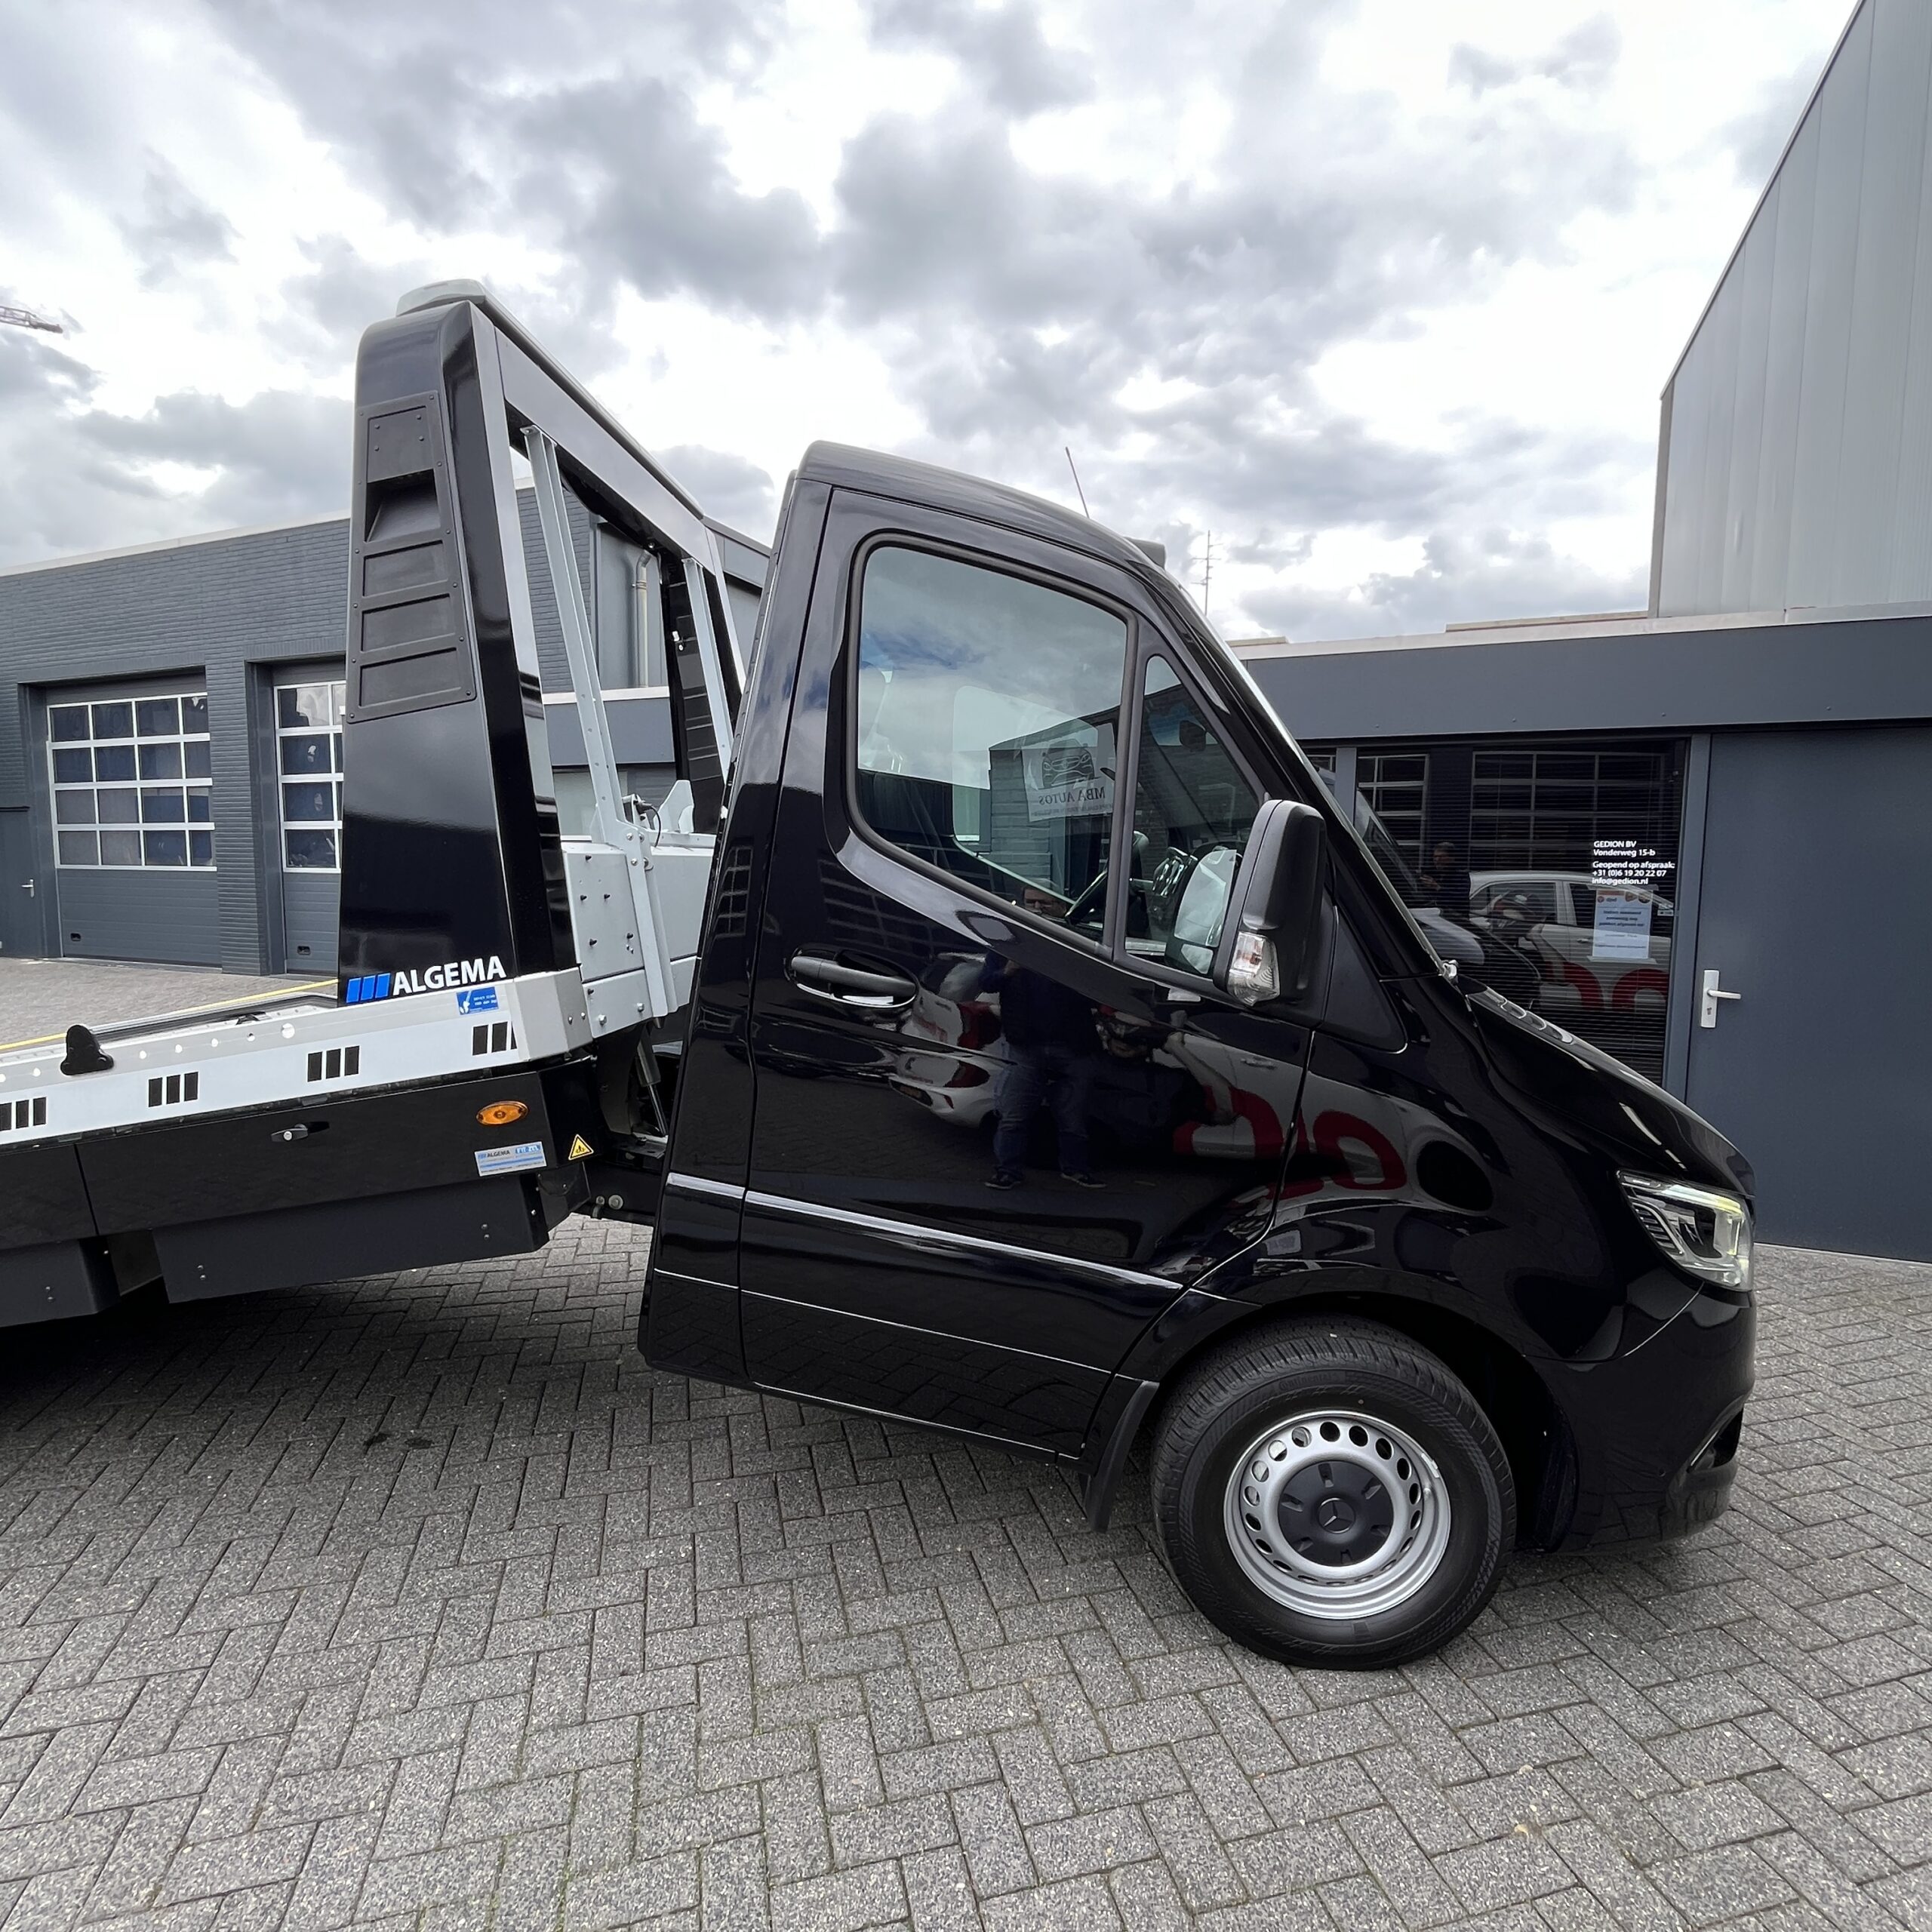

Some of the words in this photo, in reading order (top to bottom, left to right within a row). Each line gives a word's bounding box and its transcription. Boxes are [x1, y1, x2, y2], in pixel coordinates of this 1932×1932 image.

[1593, 849, 1637, 857] Vonderweg
[1592, 861, 1628, 869] Geopend
[1592, 878, 1649, 886] info@gedion.nl
[392, 955, 507, 995] ALGEMA
[487, 1149, 511, 1158] ALGEMA
